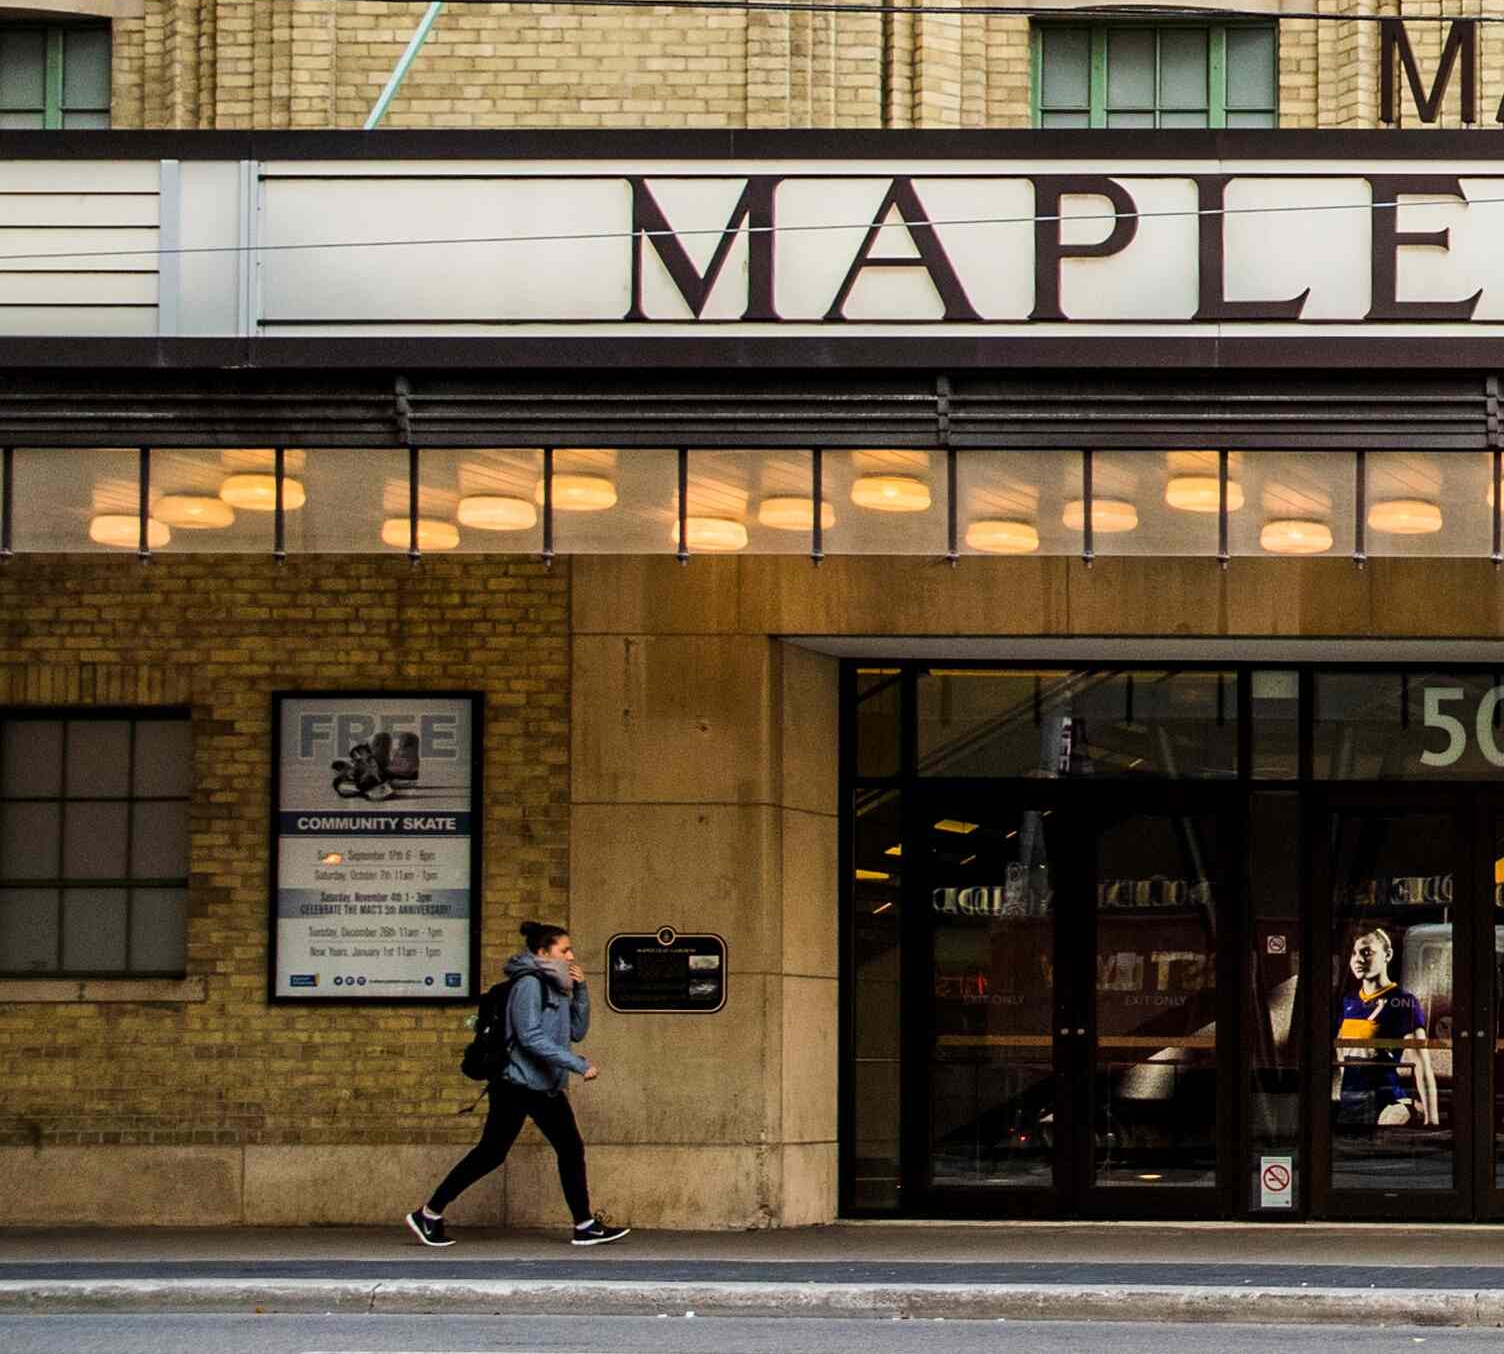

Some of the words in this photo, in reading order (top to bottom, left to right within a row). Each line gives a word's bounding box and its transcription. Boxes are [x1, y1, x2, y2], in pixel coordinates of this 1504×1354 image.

[624, 174, 1484, 322] MAPLE
[297, 817, 399, 831] COMMUNITY
[403, 817, 457, 830] SKATE
